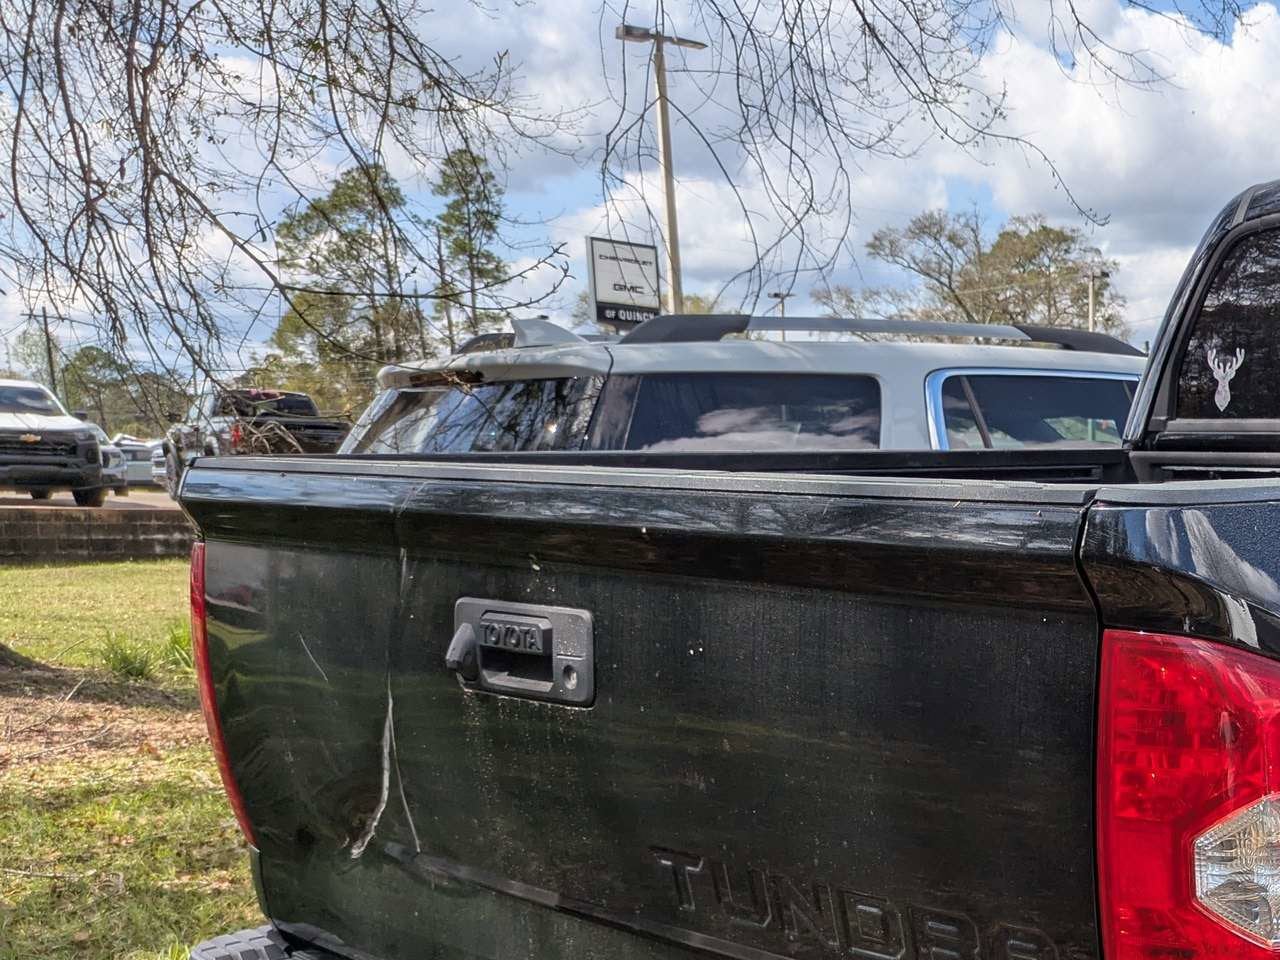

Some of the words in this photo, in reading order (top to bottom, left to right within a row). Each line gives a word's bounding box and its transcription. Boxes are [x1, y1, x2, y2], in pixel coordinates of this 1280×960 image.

[613, 283, 645, 294] GMC
[605, 310, 617, 319] OF
[480, 622, 543, 651] TOYOTA
